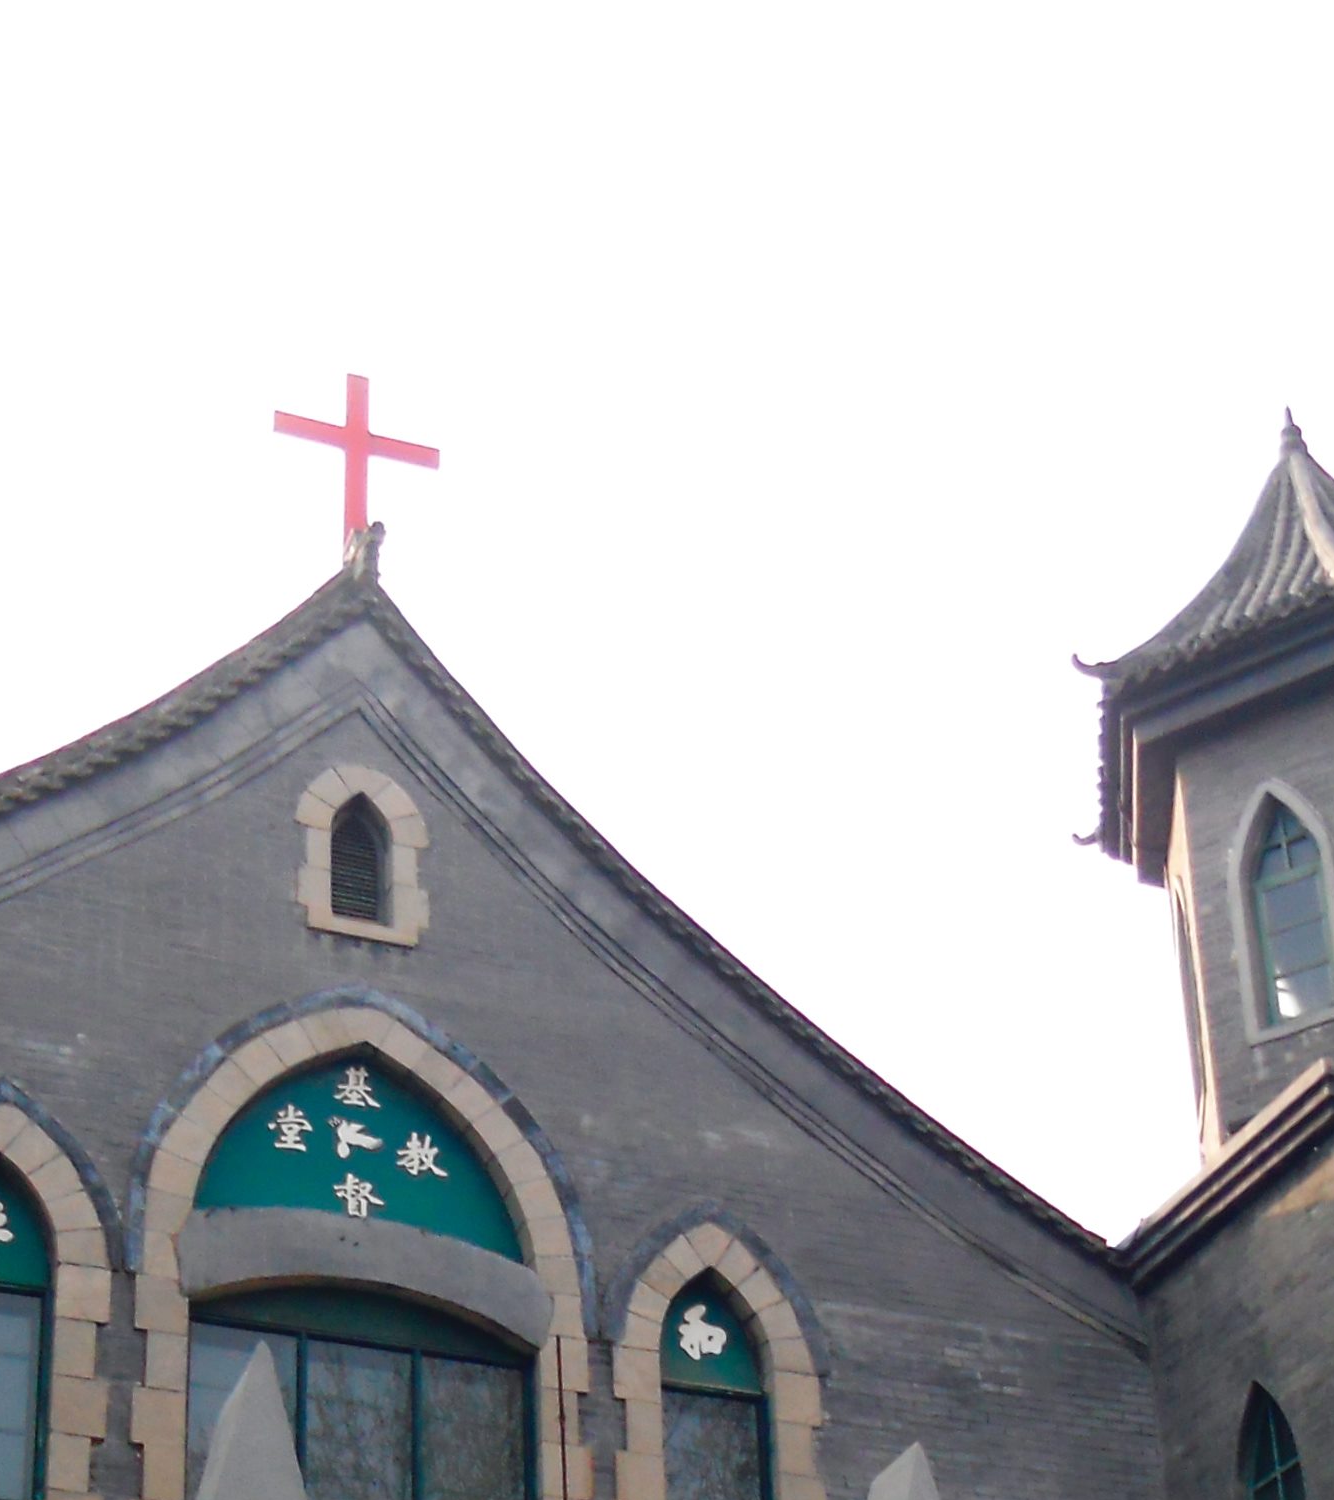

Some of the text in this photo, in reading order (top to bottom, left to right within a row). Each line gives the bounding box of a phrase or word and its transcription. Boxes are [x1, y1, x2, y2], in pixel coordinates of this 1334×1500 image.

[268, 1066, 448, 1218] 基 督 教 堂
[678, 1304, 727, 1361] 和
